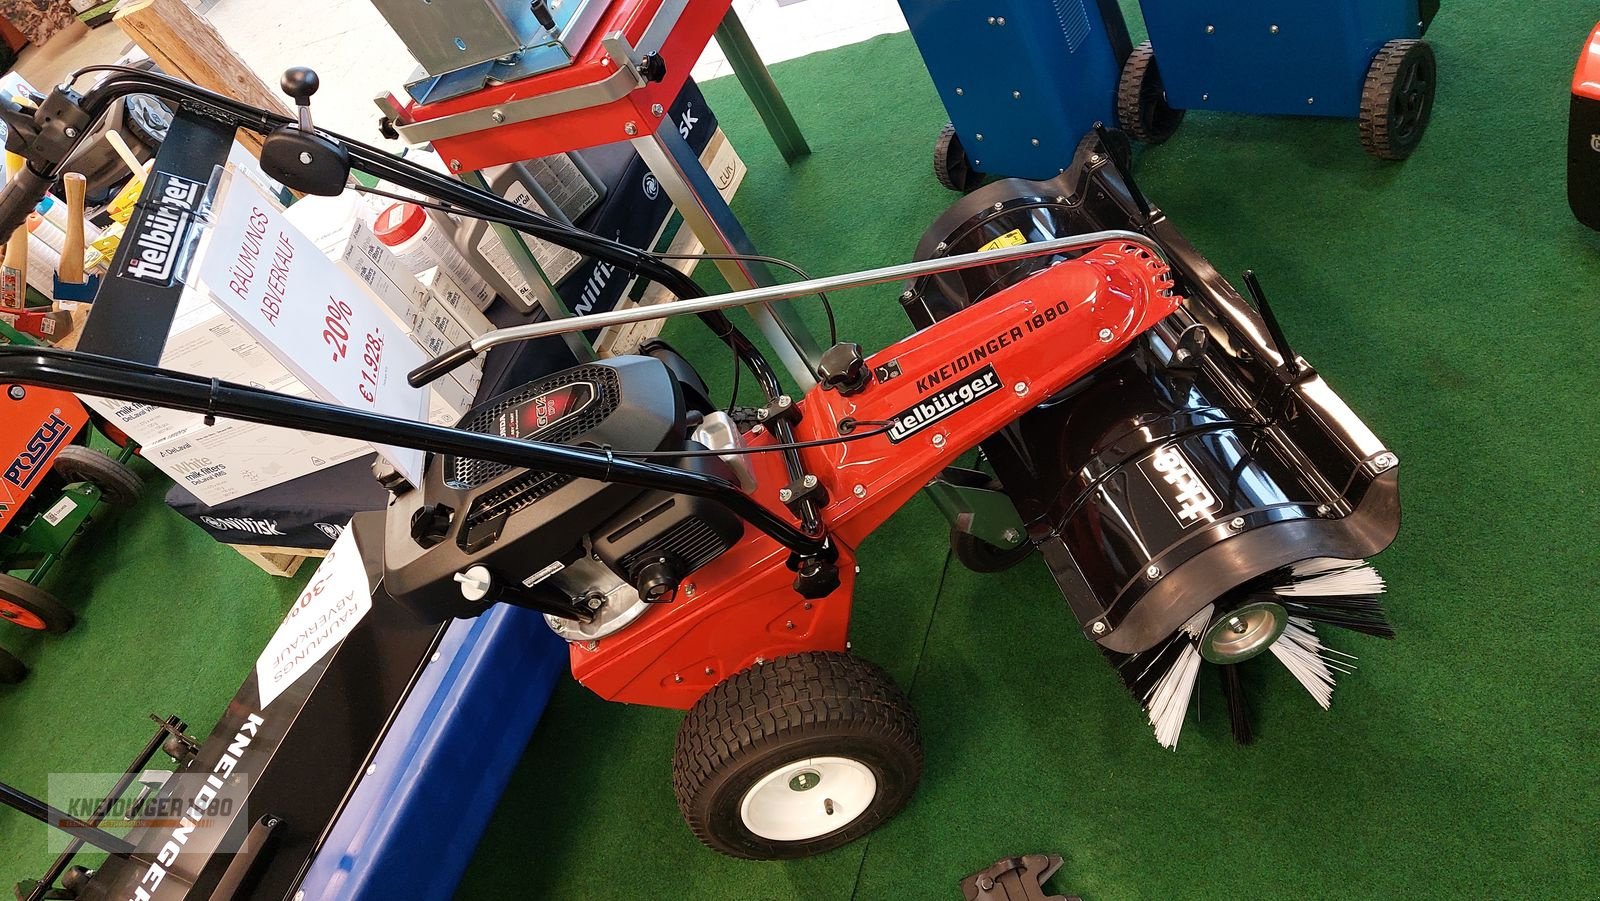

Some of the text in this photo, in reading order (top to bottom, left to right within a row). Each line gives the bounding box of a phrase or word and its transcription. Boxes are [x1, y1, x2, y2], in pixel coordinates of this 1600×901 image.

[229, 206, 269, 300] RÄUMUNGS
[260, 231, 295, 327] ABVERKAUF
[323, 295, 353, 362] -20%
[916, 300, 1070, 394] KNEIDINGER 1880
[359, 327, 384, 402] € 1.928,-
[115, 402, 134, 418] milk
[499, 413, 507, 437] ONDA
[2, 413, 66, 486] POSCH
[168, 442, 192, 456] DeLaval
[170, 455, 213, 474] White
[185, 463, 226, 481] milk filters
[217, 517, 286, 536] Nilfisk
[273, 590, 354, 668] ABVERKAUF
